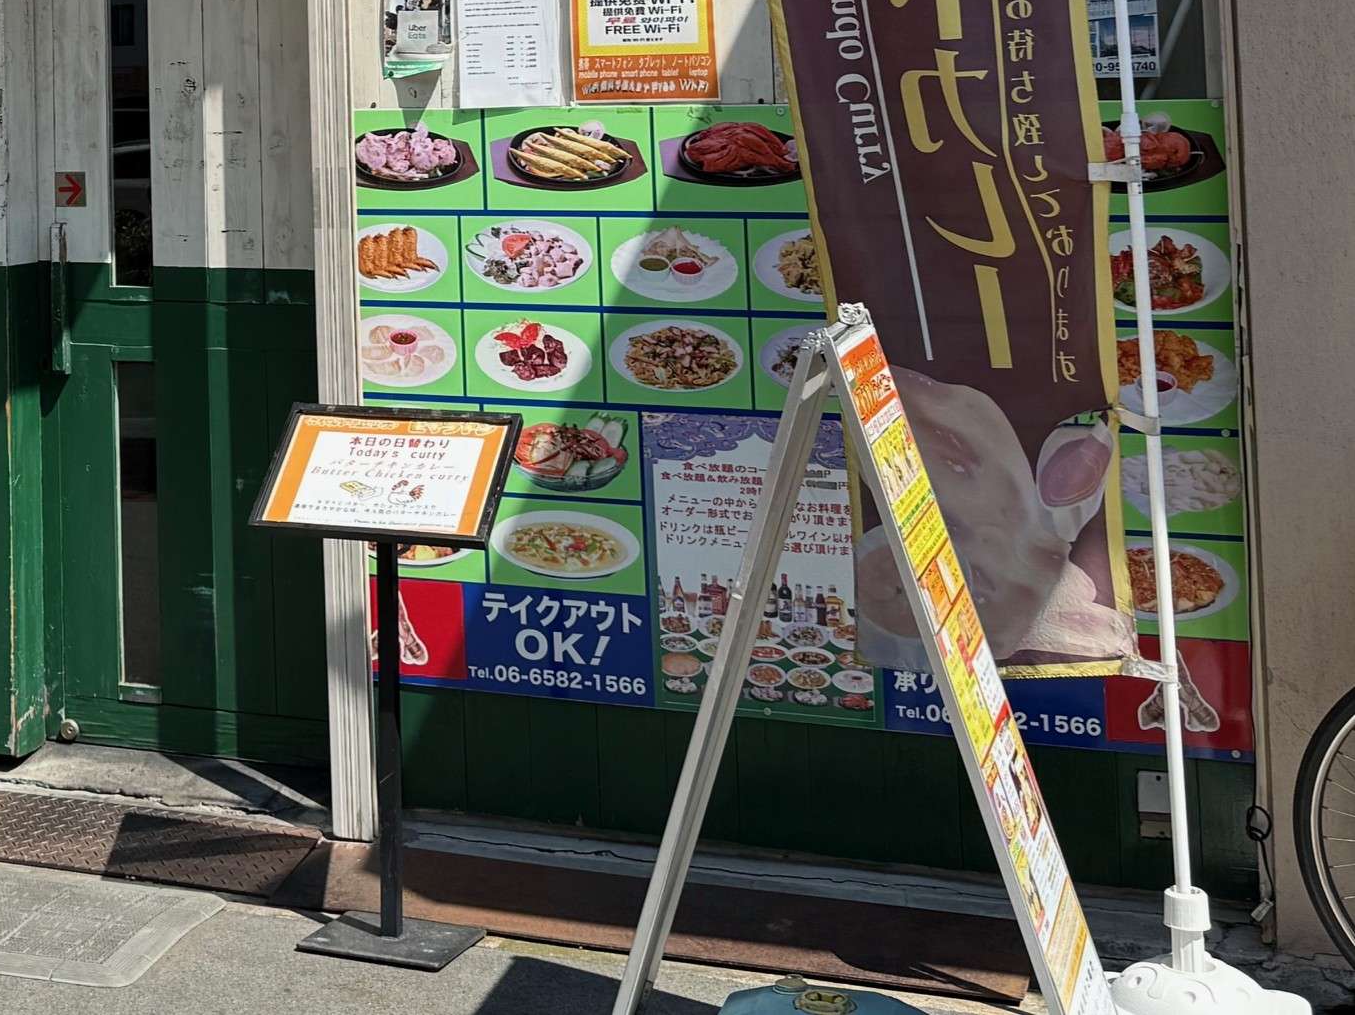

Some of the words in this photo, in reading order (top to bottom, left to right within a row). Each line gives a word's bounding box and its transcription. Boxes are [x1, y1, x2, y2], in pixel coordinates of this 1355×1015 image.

[648, 5, 682, 16] Wi-Fi
[640, 15, 689, 24] 와이파이
[407, 25, 427, 33] Uber
[605, 25, 641, 35] FREE
[644, 23, 680, 34] Wi-Fi
[348, 436, 450, 449] 本日の日替わり
[410, 450, 447, 461] curry
[310, 466, 357, 477] Butter
[365, 467, 424, 480] Chicken
[667, 495, 757, 510] メニューの中から
[661, 507, 753, 522] オーダー形式でお
[482, 591, 643, 634] テイクアウト
[515, 629, 610, 667] OK!
